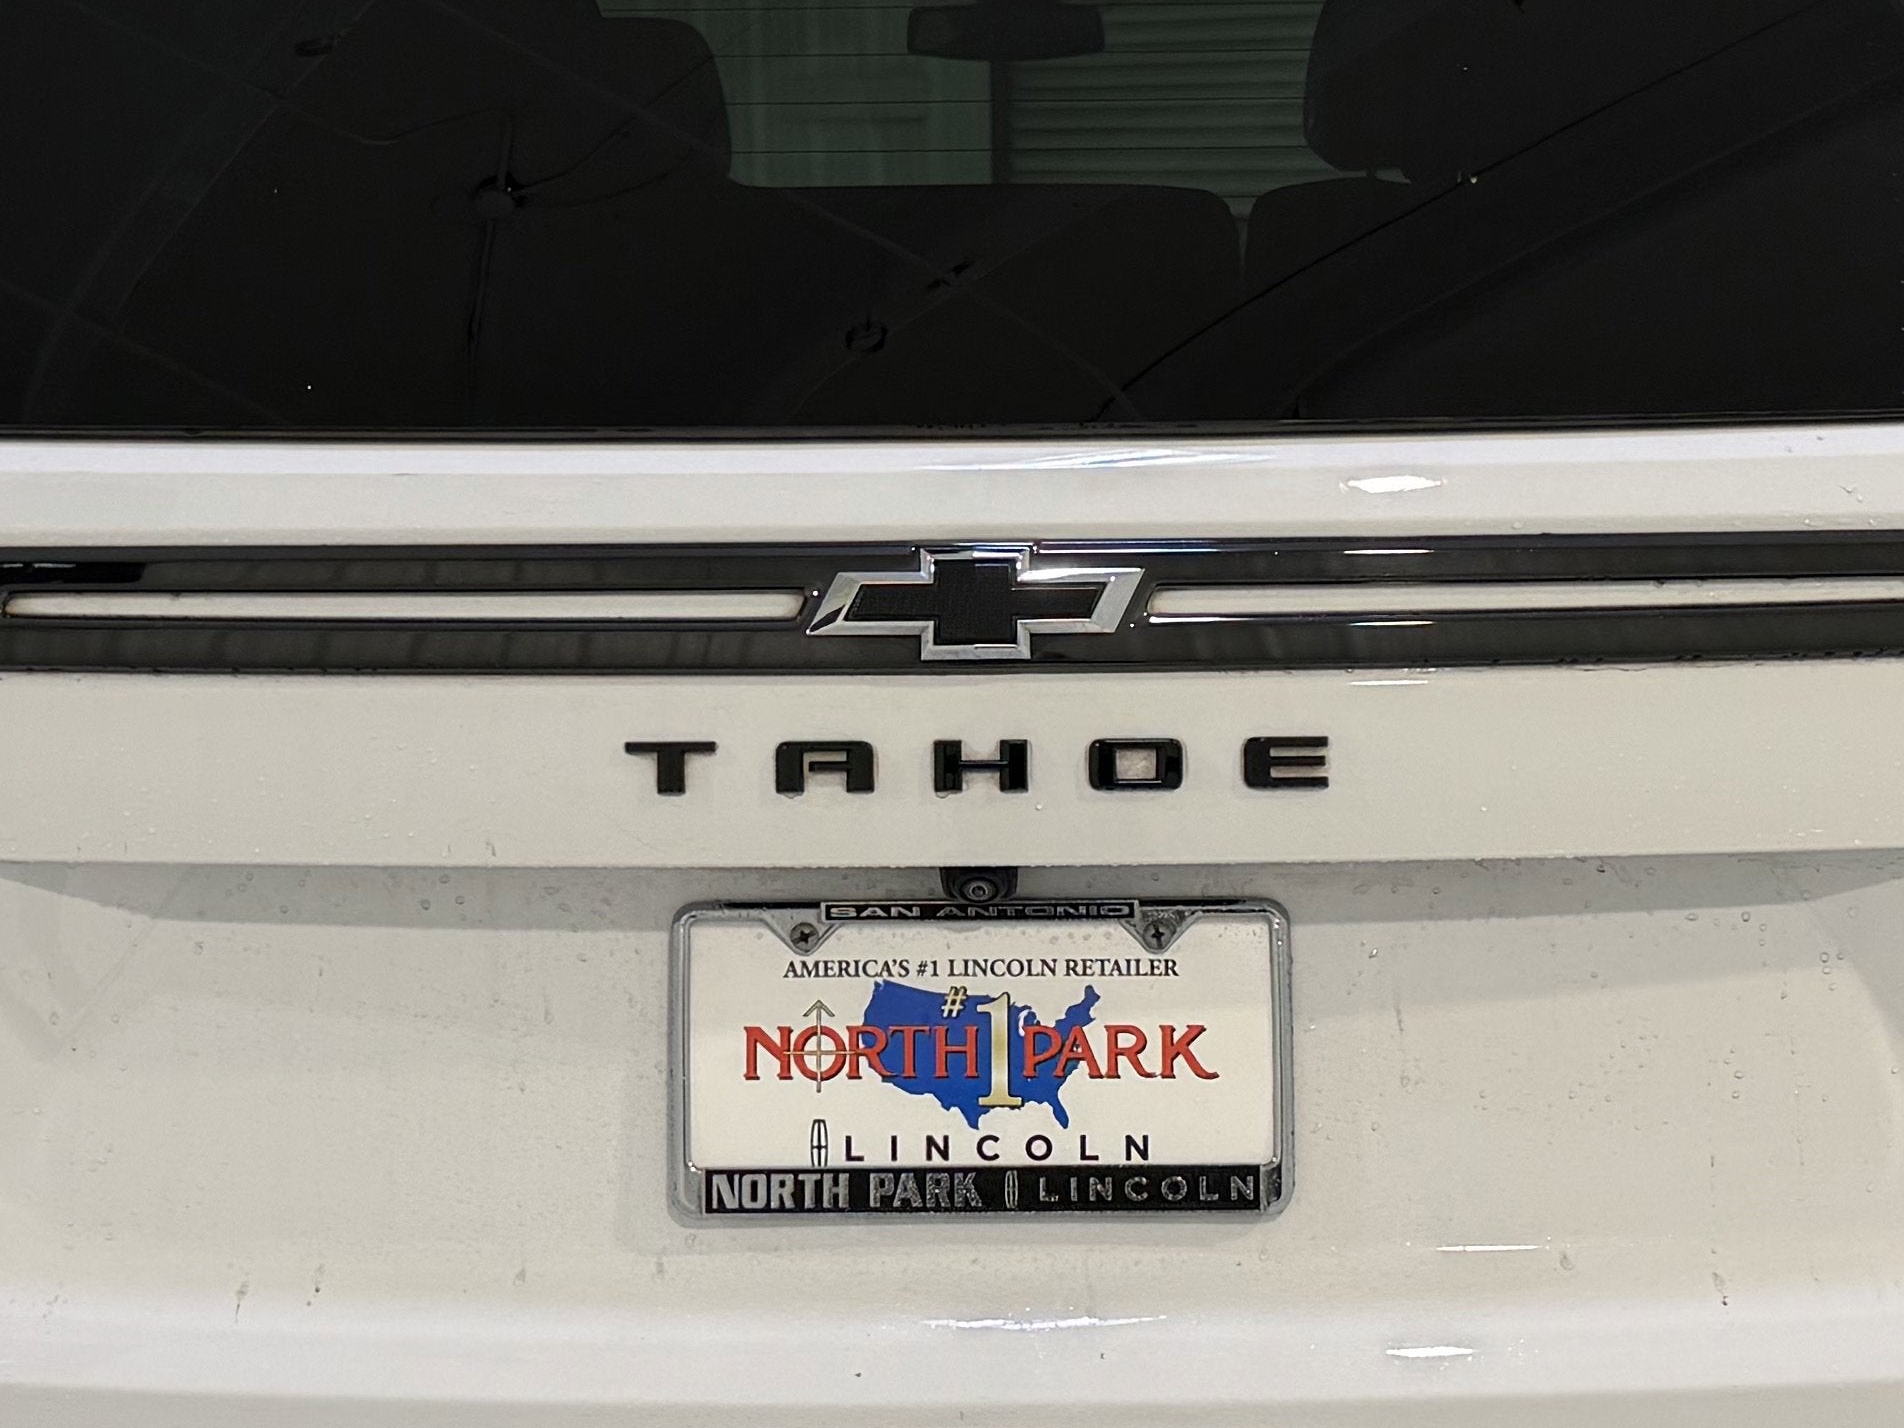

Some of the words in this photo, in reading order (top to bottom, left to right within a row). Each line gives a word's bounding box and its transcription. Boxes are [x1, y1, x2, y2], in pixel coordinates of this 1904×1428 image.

[624, 736, 1330, 796] TAHOE
[830, 905, 921, 918] SAN
[936, 904, 1131, 918] ANTONIO
[783, 959, 910, 978] AMERICA'S
[916, 959, 939, 978] #1
[947, 959, 1058, 978] LINCOLN
[1064, 959, 1179, 978] RETAILER
[743, 1025, 978, 1081] NORTH
[1023, 1025, 1220, 1080] PARK
[845, 1135, 1149, 1162] LINCOLN
[711, 1174, 849, 1209] NORTH
[870, 1174, 983, 1208] PARK
[1038, 1176, 1254, 1203] LINCOLN
